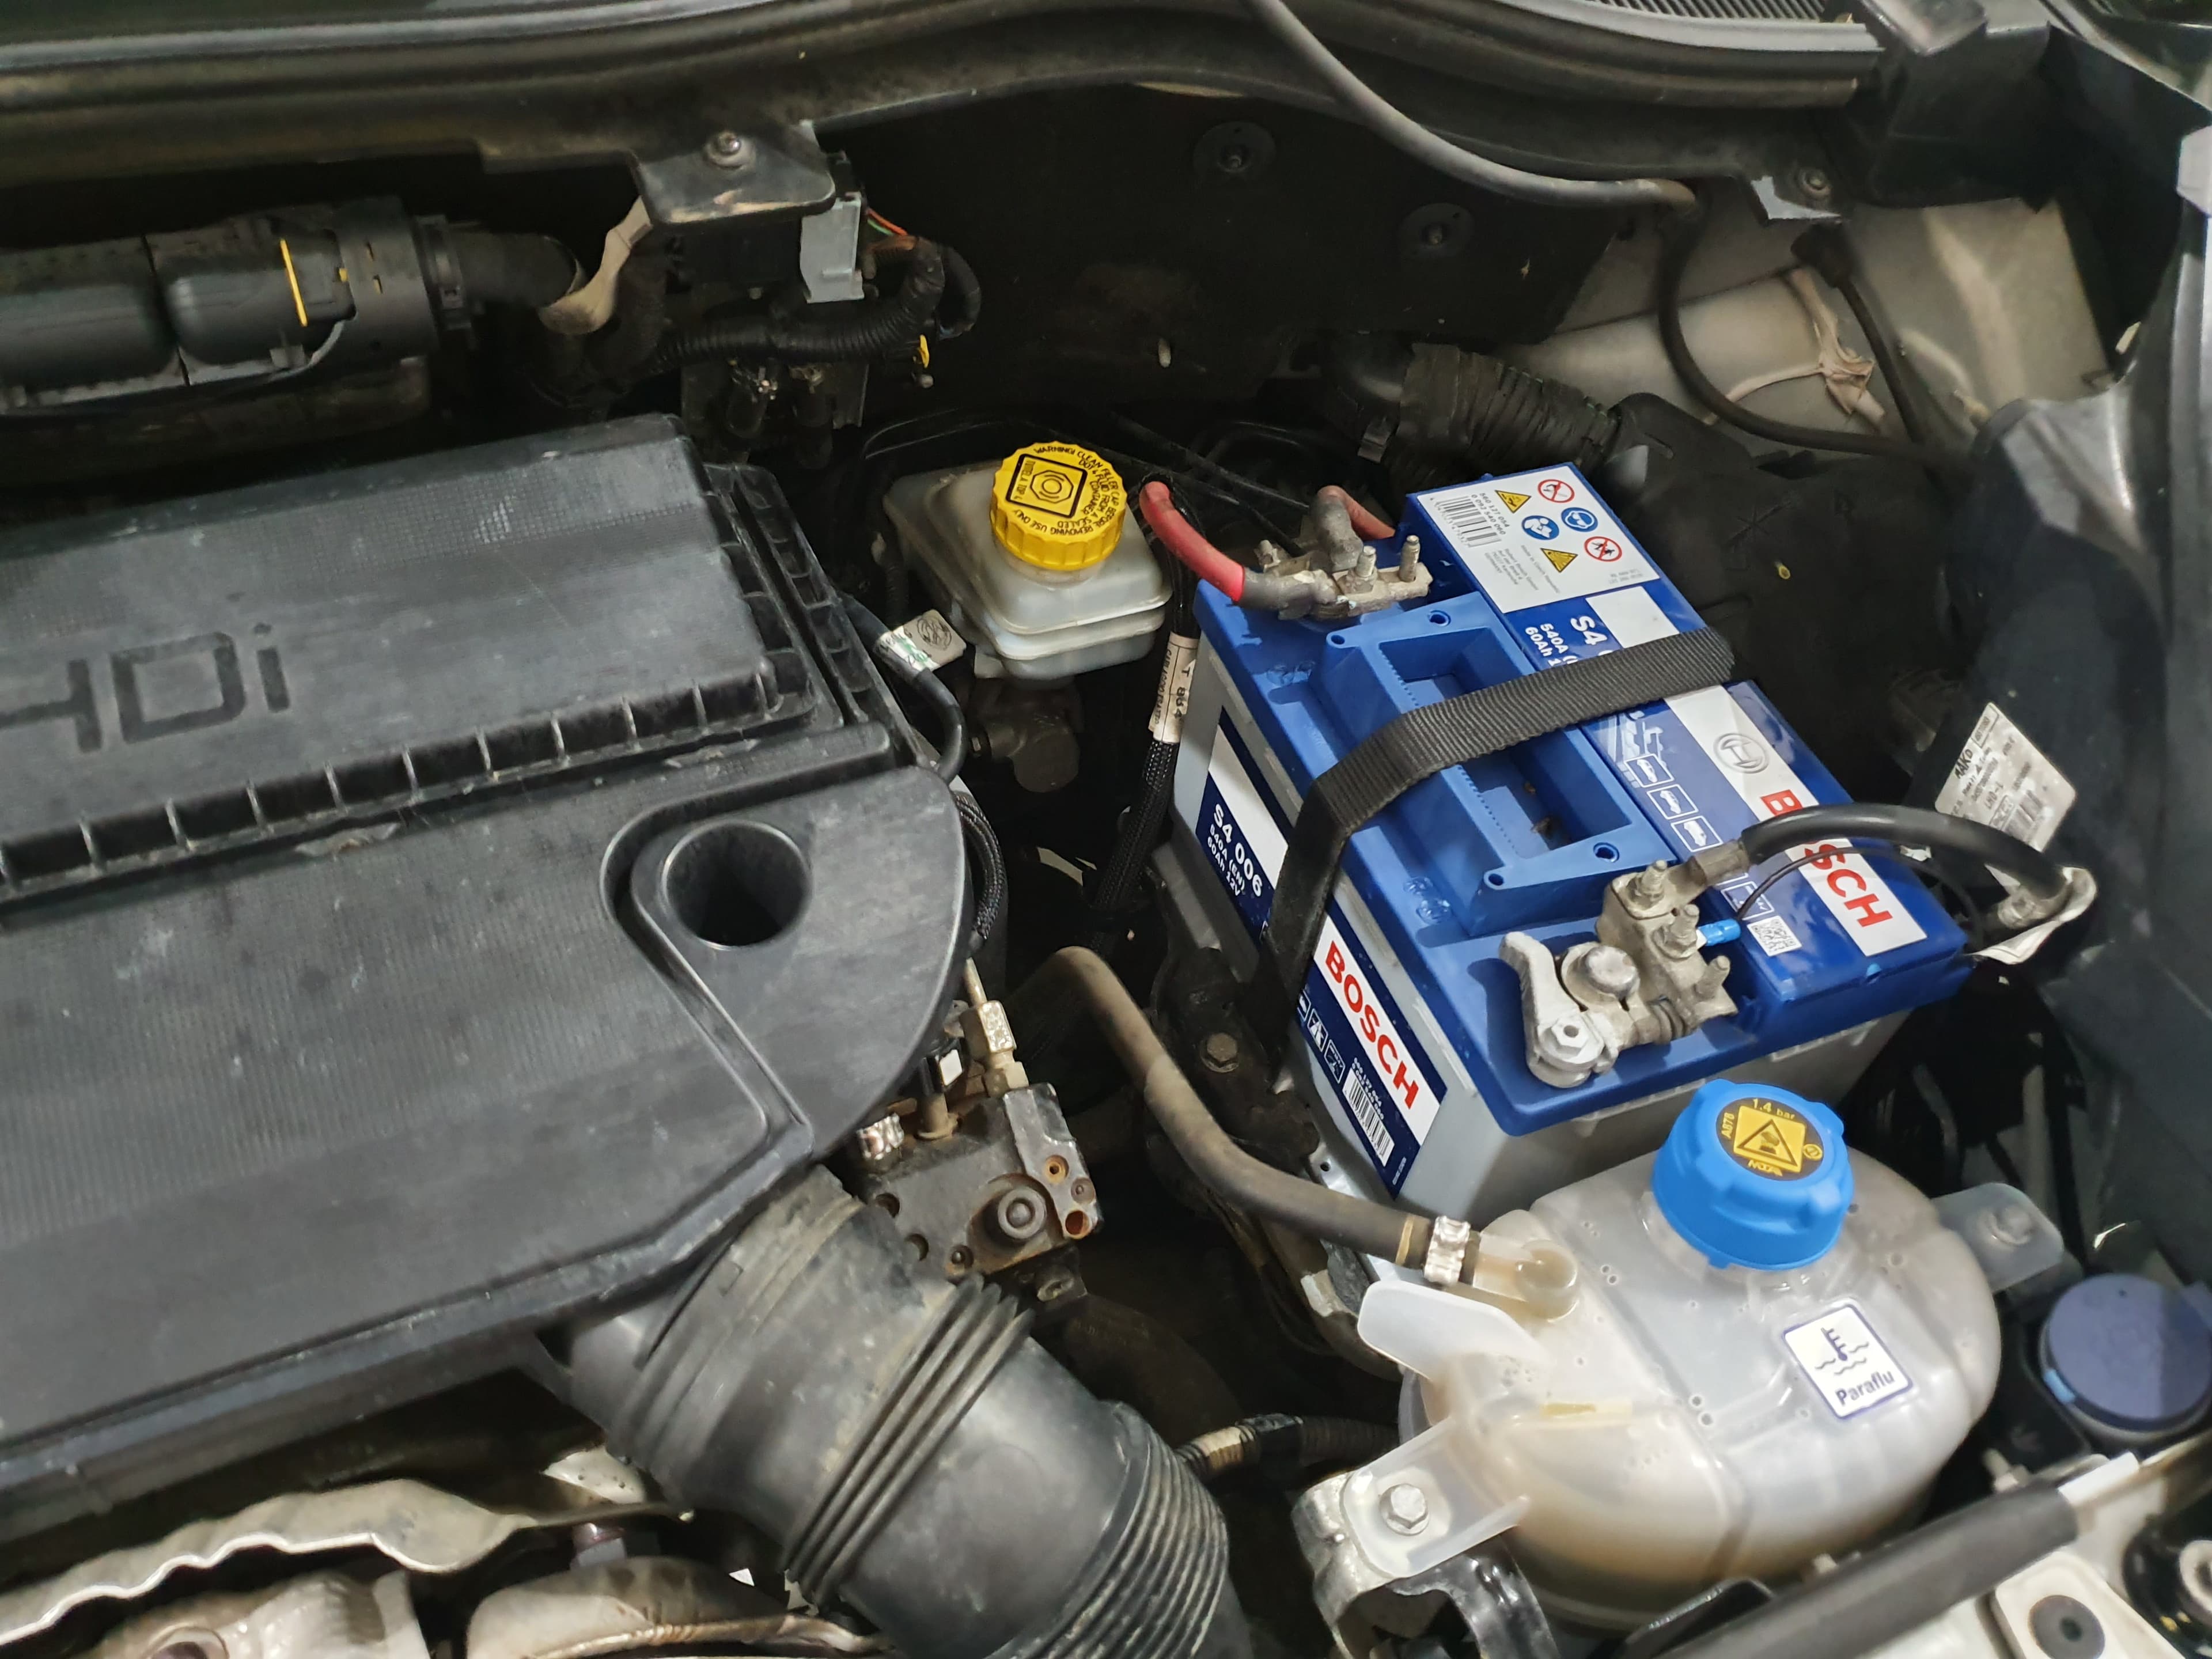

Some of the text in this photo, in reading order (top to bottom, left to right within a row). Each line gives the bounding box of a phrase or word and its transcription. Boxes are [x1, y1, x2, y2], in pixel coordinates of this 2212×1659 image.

[1077, 451, 1103, 468] CLEAN
[1079, 459, 1093, 470] DOT
[1083, 481, 1100, 514] CONTAINER
[1097, 494, 1111, 512] FROM
[1111, 491, 1119, 506] CAP
[1013, 509, 1031, 524] ONLY
[1031, 520, 1047, 532] USE
[1058, 517, 1092, 528] SEALED
[1093, 507, 1116, 528] BEFORE
[1051, 525, 1093, 536] REMOVING
[1540, 623, 1569, 654] 540A
[1570, 616, 1607, 645] S4
[1525, 627, 1553, 657] 60Ah
[1181, 666, 1191, 677] T
[1210, 823, 1245, 891] 540A (EN)
[1214, 804, 1263, 897] S4 006
[1760, 789, 1893, 927] BSCH
[1207, 836, 1240, 896] 60Ah 12V
[1325, 940, 1419, 1110] BOSCH
[1752, 1098, 1795, 1119] 1.4 bar
[1835, 1371, 1895, 1406] Paraflu
